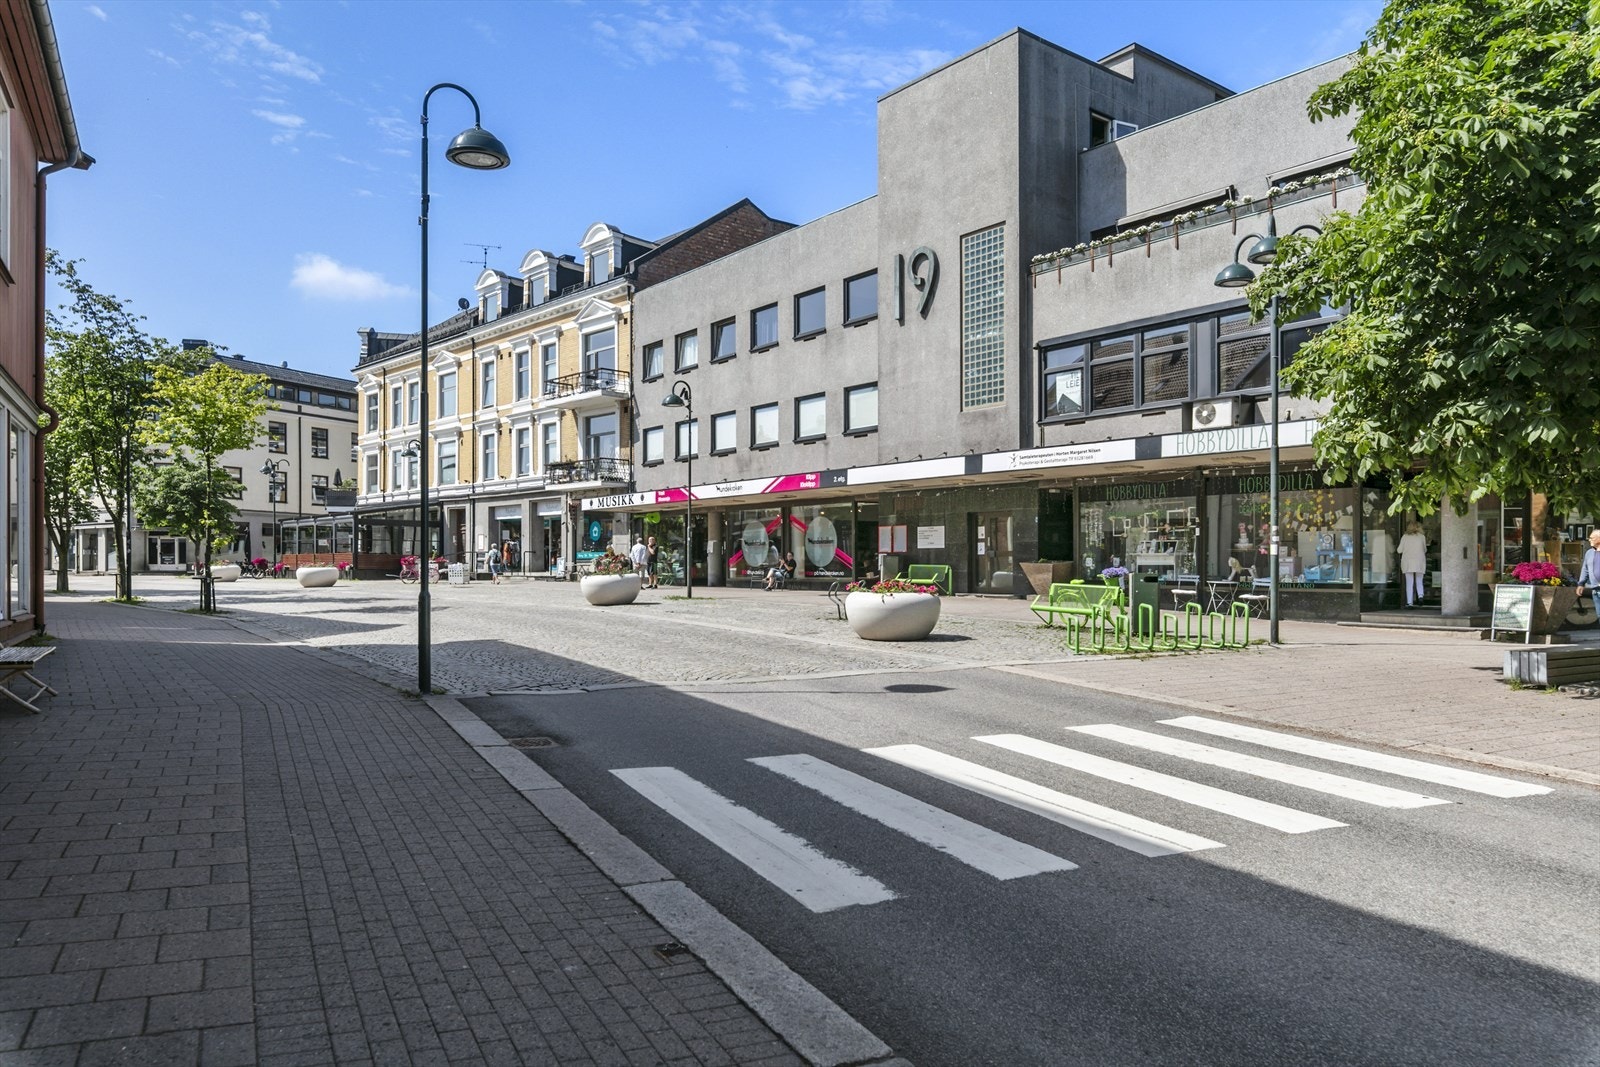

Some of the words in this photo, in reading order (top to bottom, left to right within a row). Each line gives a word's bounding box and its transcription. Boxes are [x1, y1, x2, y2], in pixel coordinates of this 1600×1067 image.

[893, 246, 940, 327] 19
[1066, 379, 1080, 388] LEIE
[1176, 425, 1269, 455] HOBBYDILLA
[1106, 482, 1167, 501] HOBBYDILLA
[1239, 474, 1314, 494] HOBBDILLA
[597, 494, 634, 508] MUSIKK
